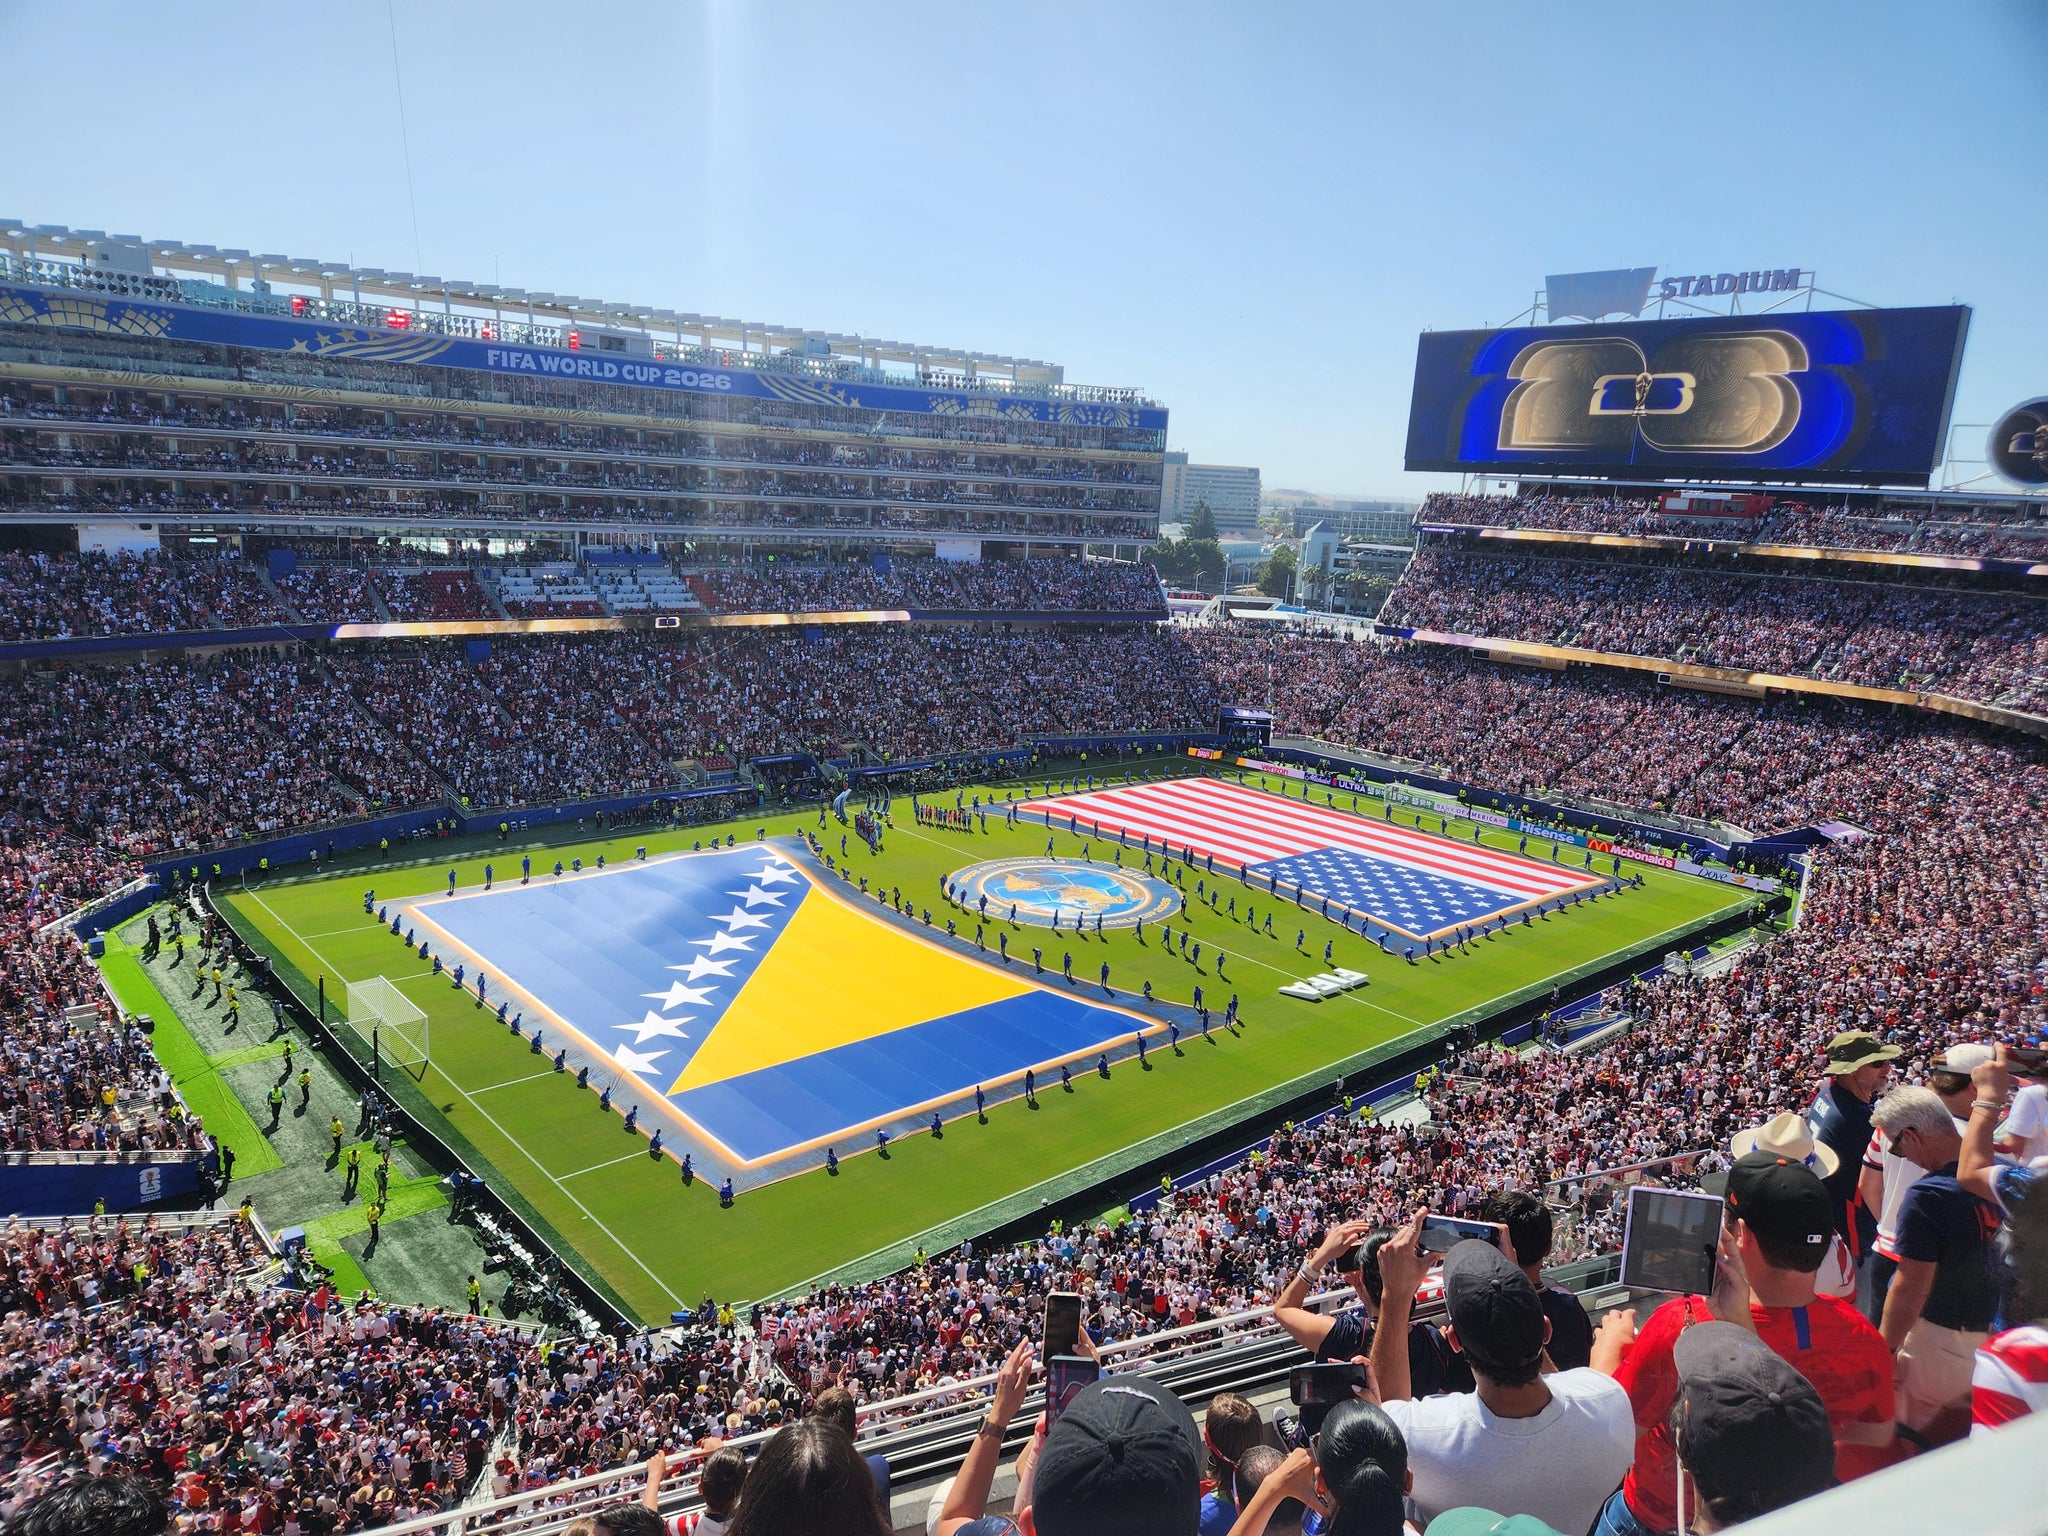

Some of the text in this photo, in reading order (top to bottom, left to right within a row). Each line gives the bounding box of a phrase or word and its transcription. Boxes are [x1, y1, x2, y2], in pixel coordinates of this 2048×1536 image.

[1660, 268, 1801, 300] STADIUM
[487, 349, 732, 390] FIFA WORLD CUP 2026
[1261, 763, 1289, 776] verizon
[1338, 780, 1366, 793] ULTRA
[1520, 821, 1575, 844] Hisense
[1645, 830, 1662, 840] FIFA
[1610, 845, 1673, 868] McDonald's
[1696, 866, 1728, 880] Dove
